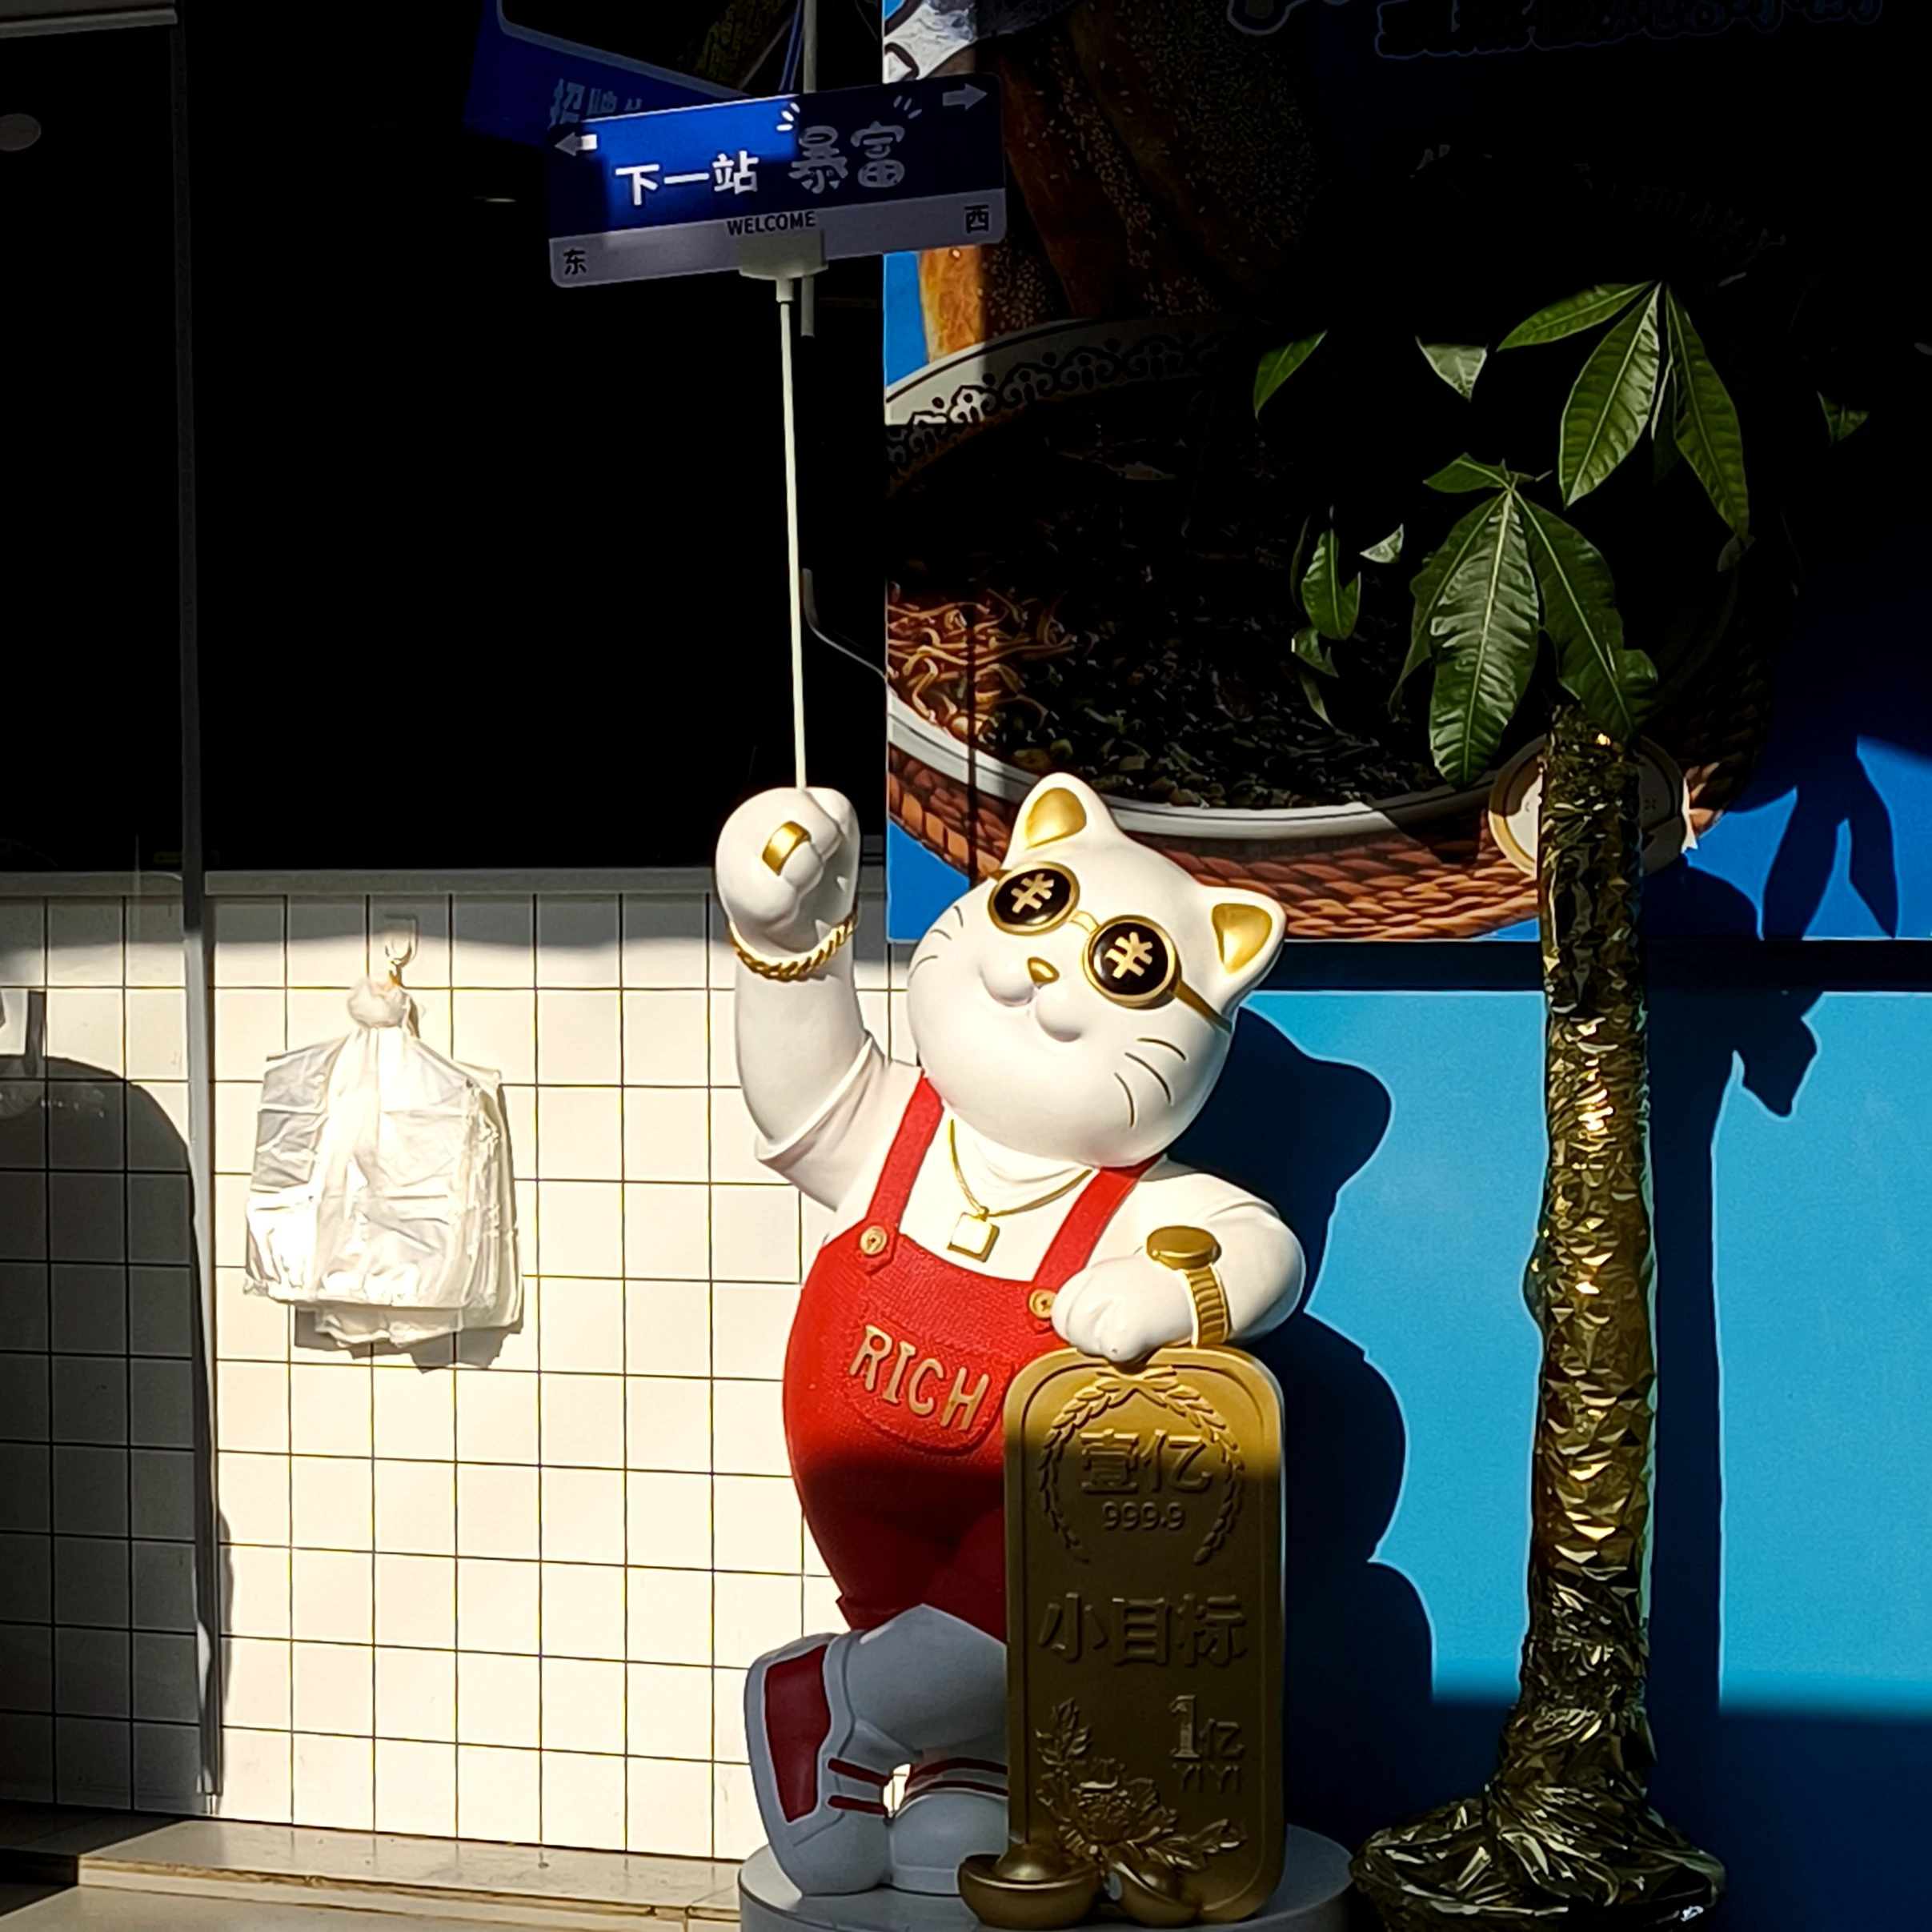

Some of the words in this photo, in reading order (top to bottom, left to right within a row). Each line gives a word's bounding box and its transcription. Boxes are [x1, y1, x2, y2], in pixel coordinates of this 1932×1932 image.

[615, 150, 759, 206] 下一站
[788, 122, 905, 194] 暴富
[727, 210, 816, 235] WELCOME
[964, 205, 989, 233] 西
[563, 249, 587, 276] 东
[849, 1325, 989, 1431] RICH
[1080, 1429, 1213, 1495] 壹亿
[1102, 1501, 1185, 1531] 999.9
[1040, 1593, 1249, 1667] 小目标
